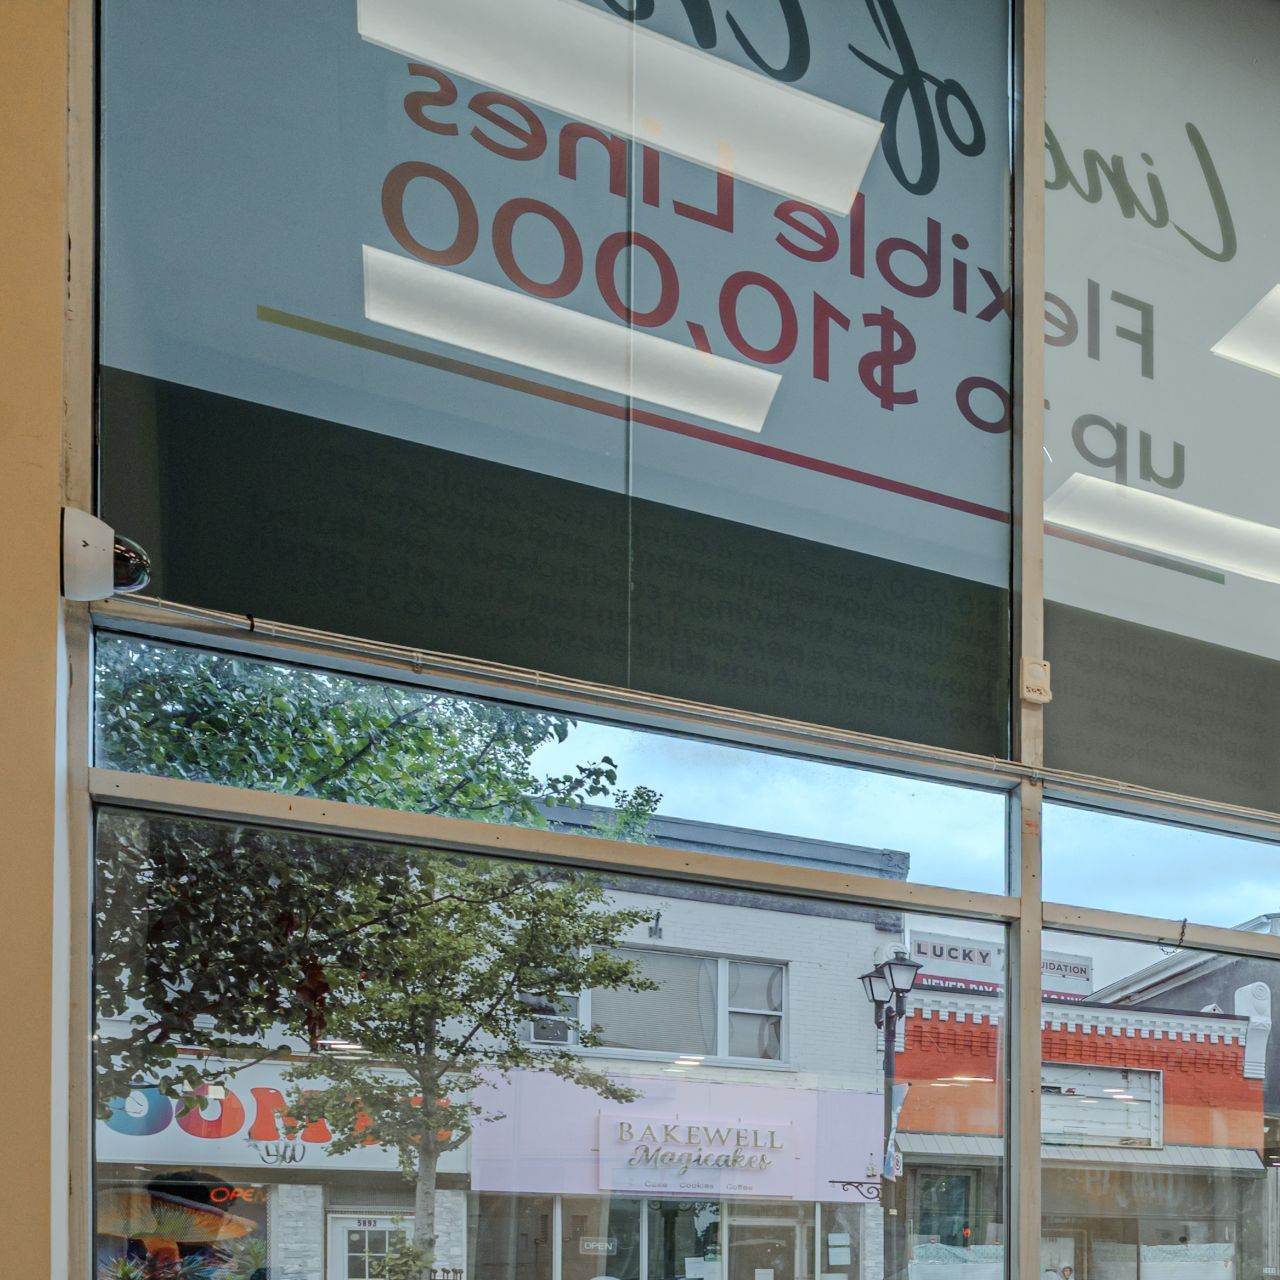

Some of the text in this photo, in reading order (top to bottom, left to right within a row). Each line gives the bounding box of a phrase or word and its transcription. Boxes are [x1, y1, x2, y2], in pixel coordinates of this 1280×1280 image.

[916, 942, 991, 964] LUCKY
[618, 1122, 784, 1150] BAKEWELL
[628, 1144, 773, 1176] Magicakes
[357, 1218, 377, 1228] 5893
[584, 1240, 613, 1252] OPEN
